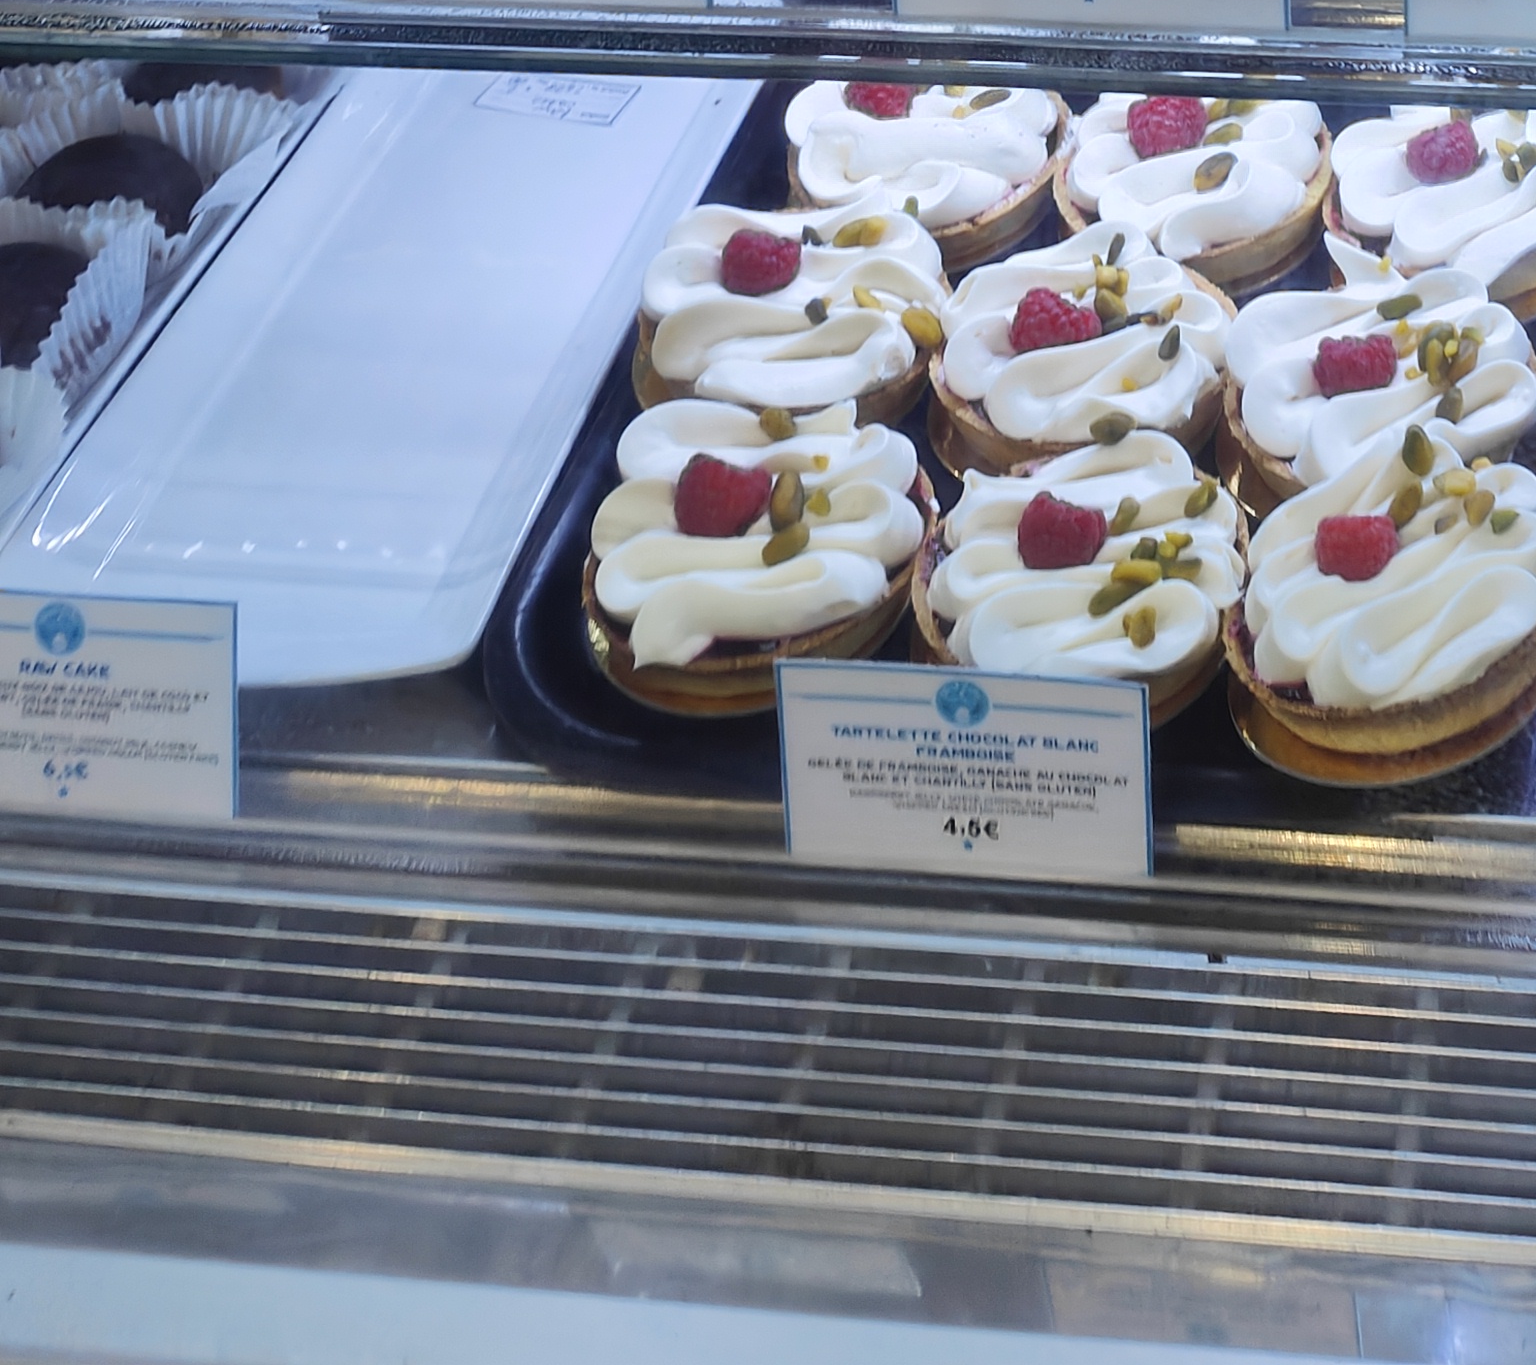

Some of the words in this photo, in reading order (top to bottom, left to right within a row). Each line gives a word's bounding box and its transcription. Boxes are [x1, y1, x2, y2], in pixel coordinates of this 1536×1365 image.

[832, 724, 941, 742] TARTELETTE
[948, 731, 1036, 748] CHOCOLAT
[1043, 736, 1099, 753] BLANC
[916, 744, 1015, 762] FRAMBOISE
